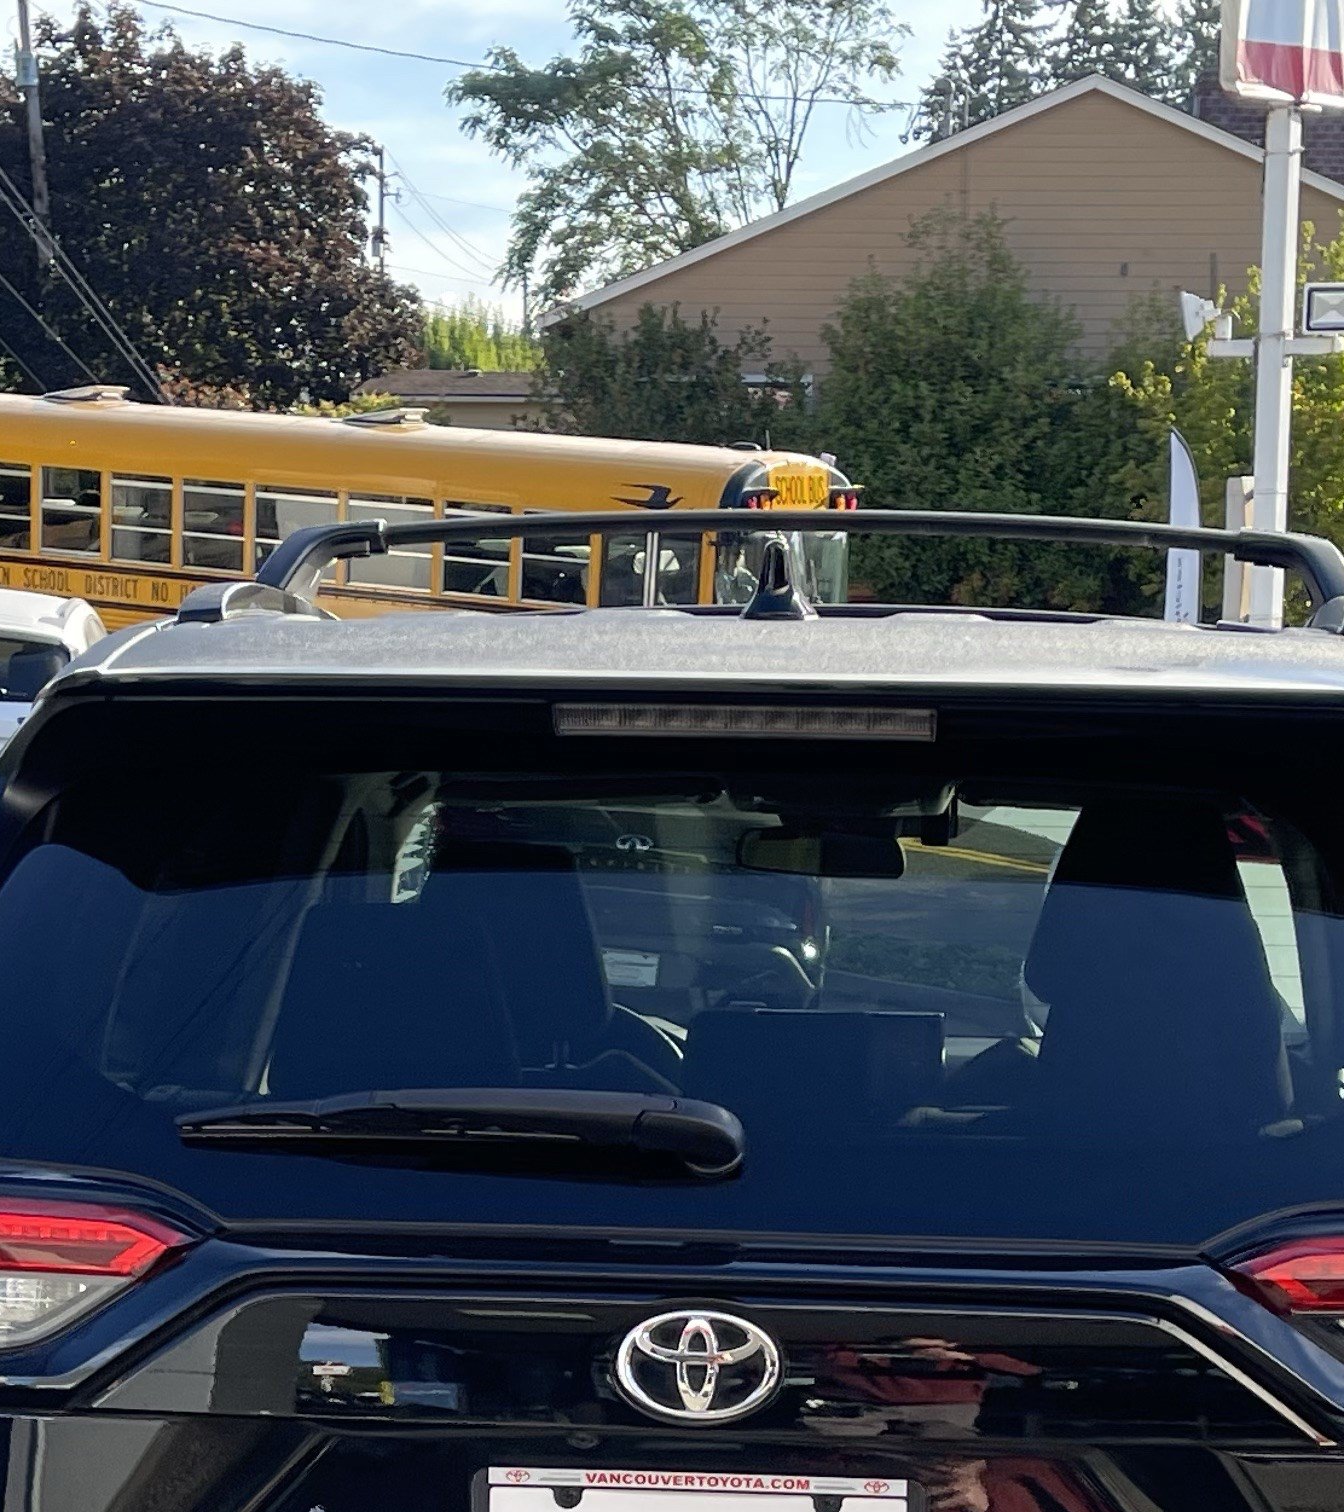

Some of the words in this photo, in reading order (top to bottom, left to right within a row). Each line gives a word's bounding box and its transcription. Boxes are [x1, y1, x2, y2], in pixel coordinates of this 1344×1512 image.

[23, 567, 72, 593] SCHOOL
[84, 574, 140, 600] DISTRICT
[584, 1472, 811, 1491] VANCOUVERTOYOTA.COM
